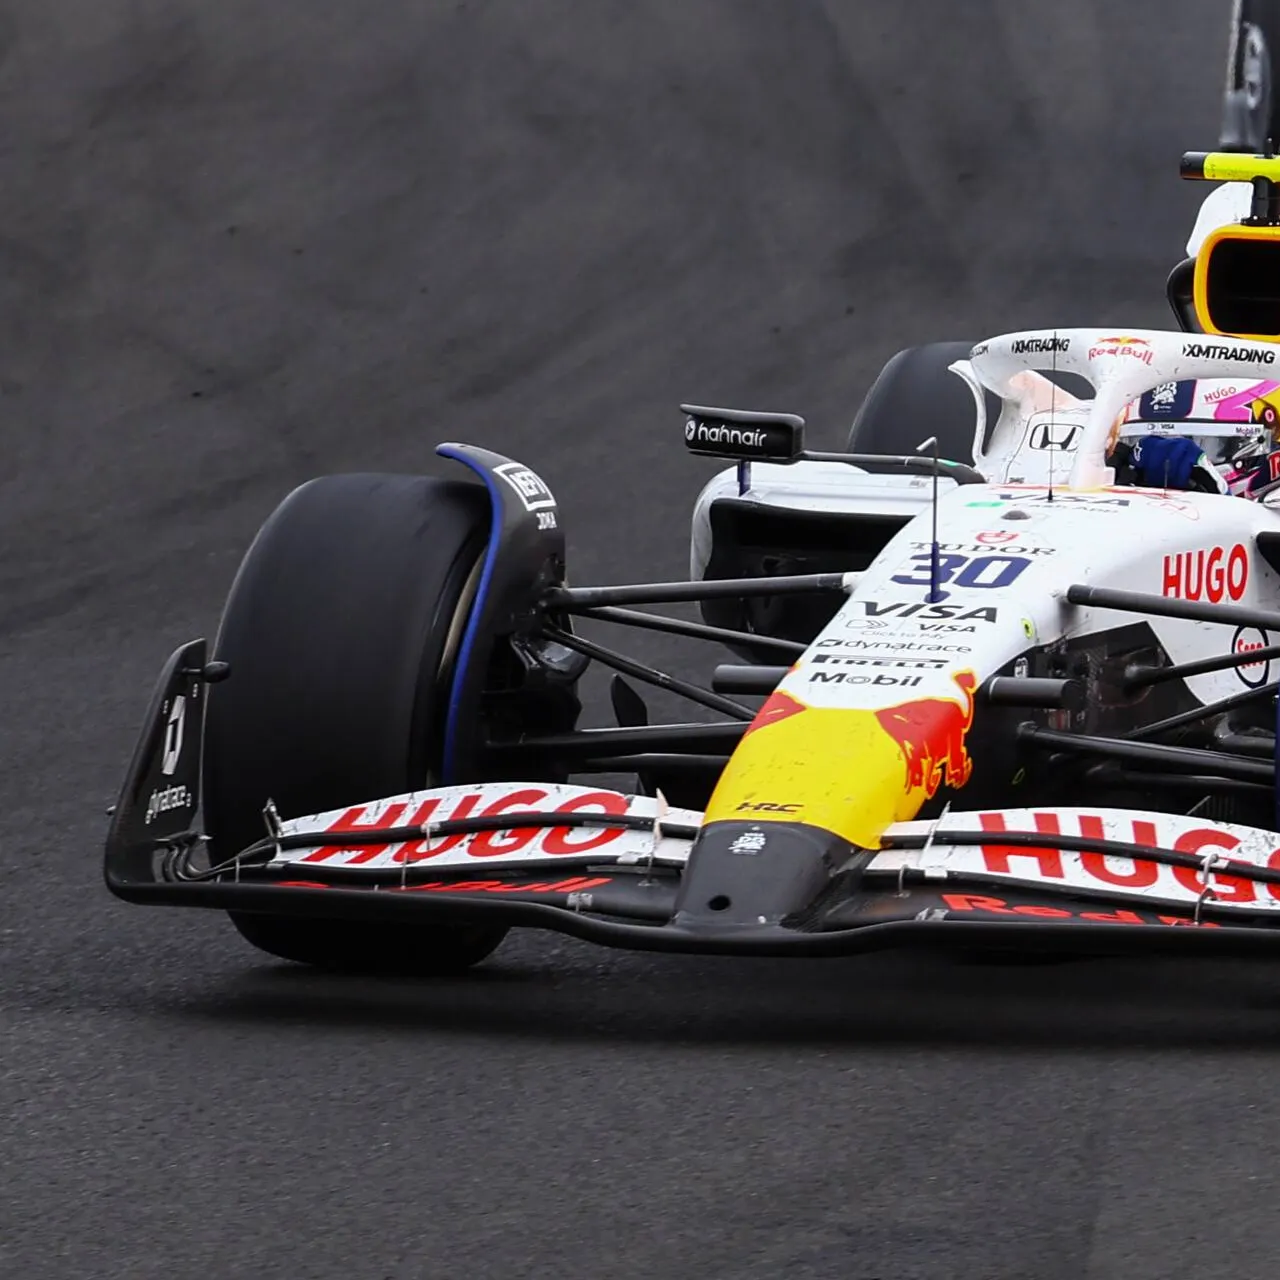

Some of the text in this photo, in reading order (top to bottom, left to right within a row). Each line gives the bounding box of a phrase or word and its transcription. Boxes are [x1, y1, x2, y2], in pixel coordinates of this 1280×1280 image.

[1120, 346, 1154, 366] Bull
[1203, 386, 1237, 403] HUGO
[697, 422, 767, 448] hahnair
[910, 542, 1056, 555] TUDOR
[890, 553, 1033, 589] 30
[1162, 543, 1249, 604] HUGO
[856, 601, 998, 623] VISA
[918, 623, 977, 633] VISA
[843, 639, 973, 653] dynatrace
[810, 654, 950, 669] PIRELLI
[808, 672, 924, 687] Mobil
[736, 802, 804, 813] HRC
[305, 789, 632, 865] HUGO
